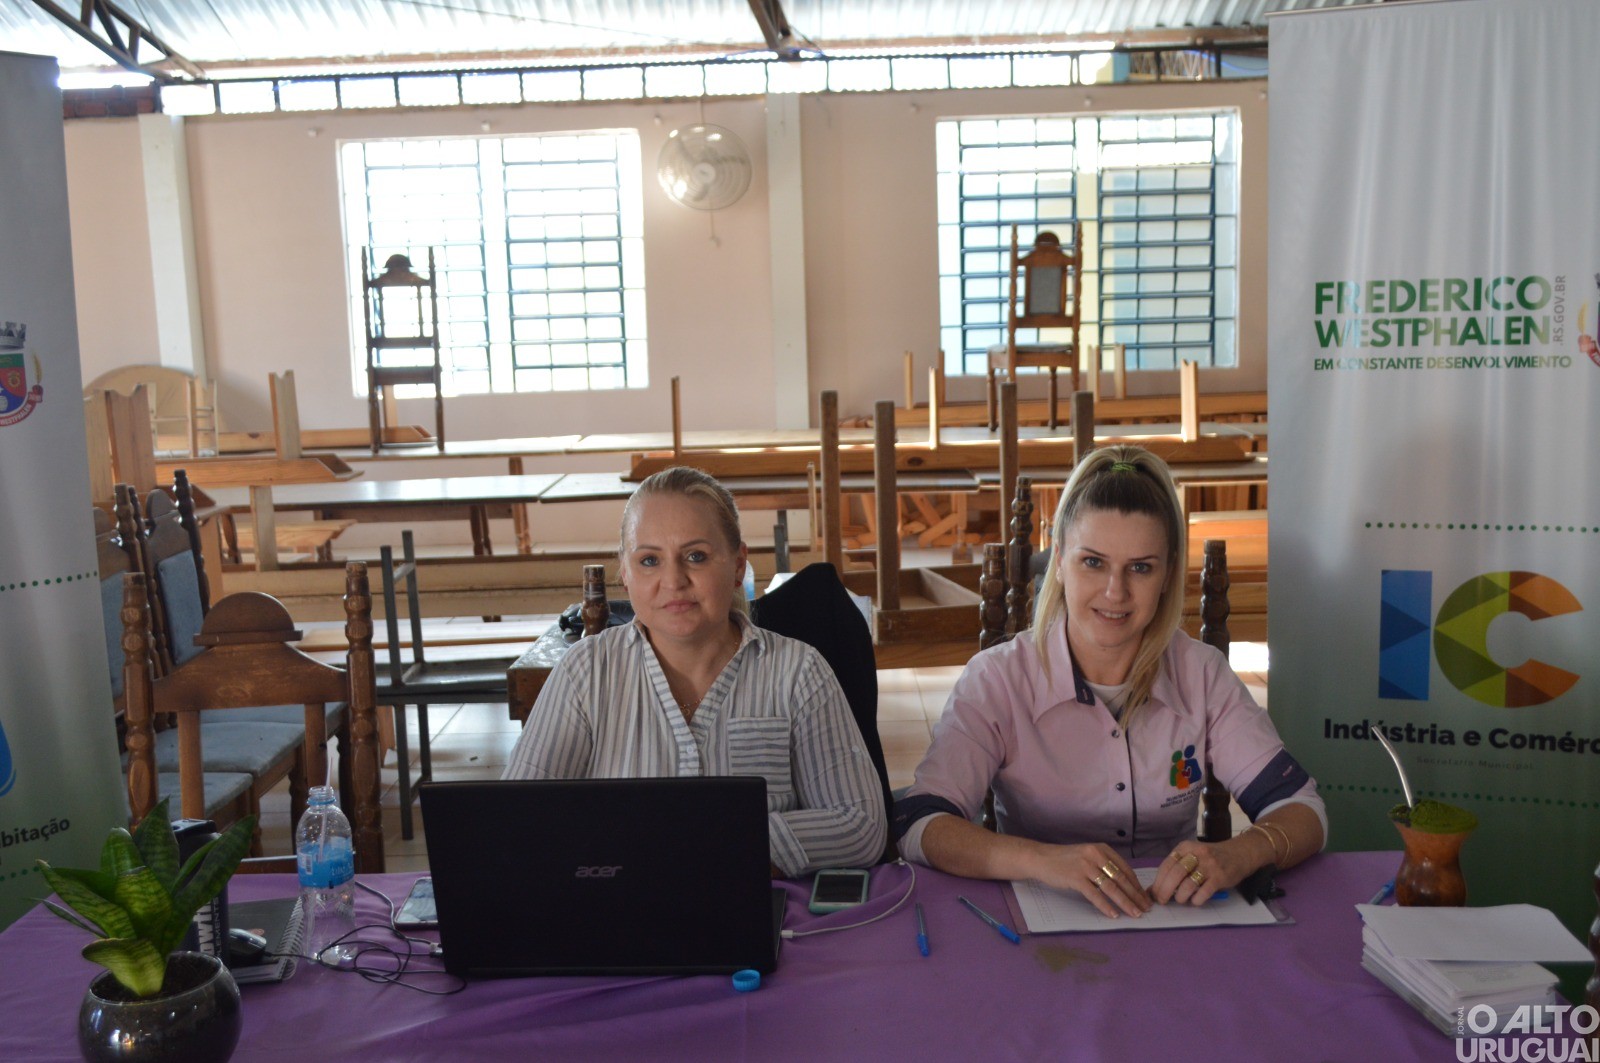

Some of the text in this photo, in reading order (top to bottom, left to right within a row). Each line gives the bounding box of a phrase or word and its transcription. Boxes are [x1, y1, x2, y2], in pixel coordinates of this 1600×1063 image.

[1315, 275, 1552, 315] FREDERICO
[1314, 315, 1551, 348] WESTPHALEN
[1314, 355, 1572, 371] EM CONSTANTE DESENVOLVIMENTO
[1378, 569, 1585, 709] IC
[1324, 718, 1456, 746] Indústria
[1463, 732, 1482, 747] e
[0, 817, 71, 848] bitação
[575, 866, 623, 877] acer
